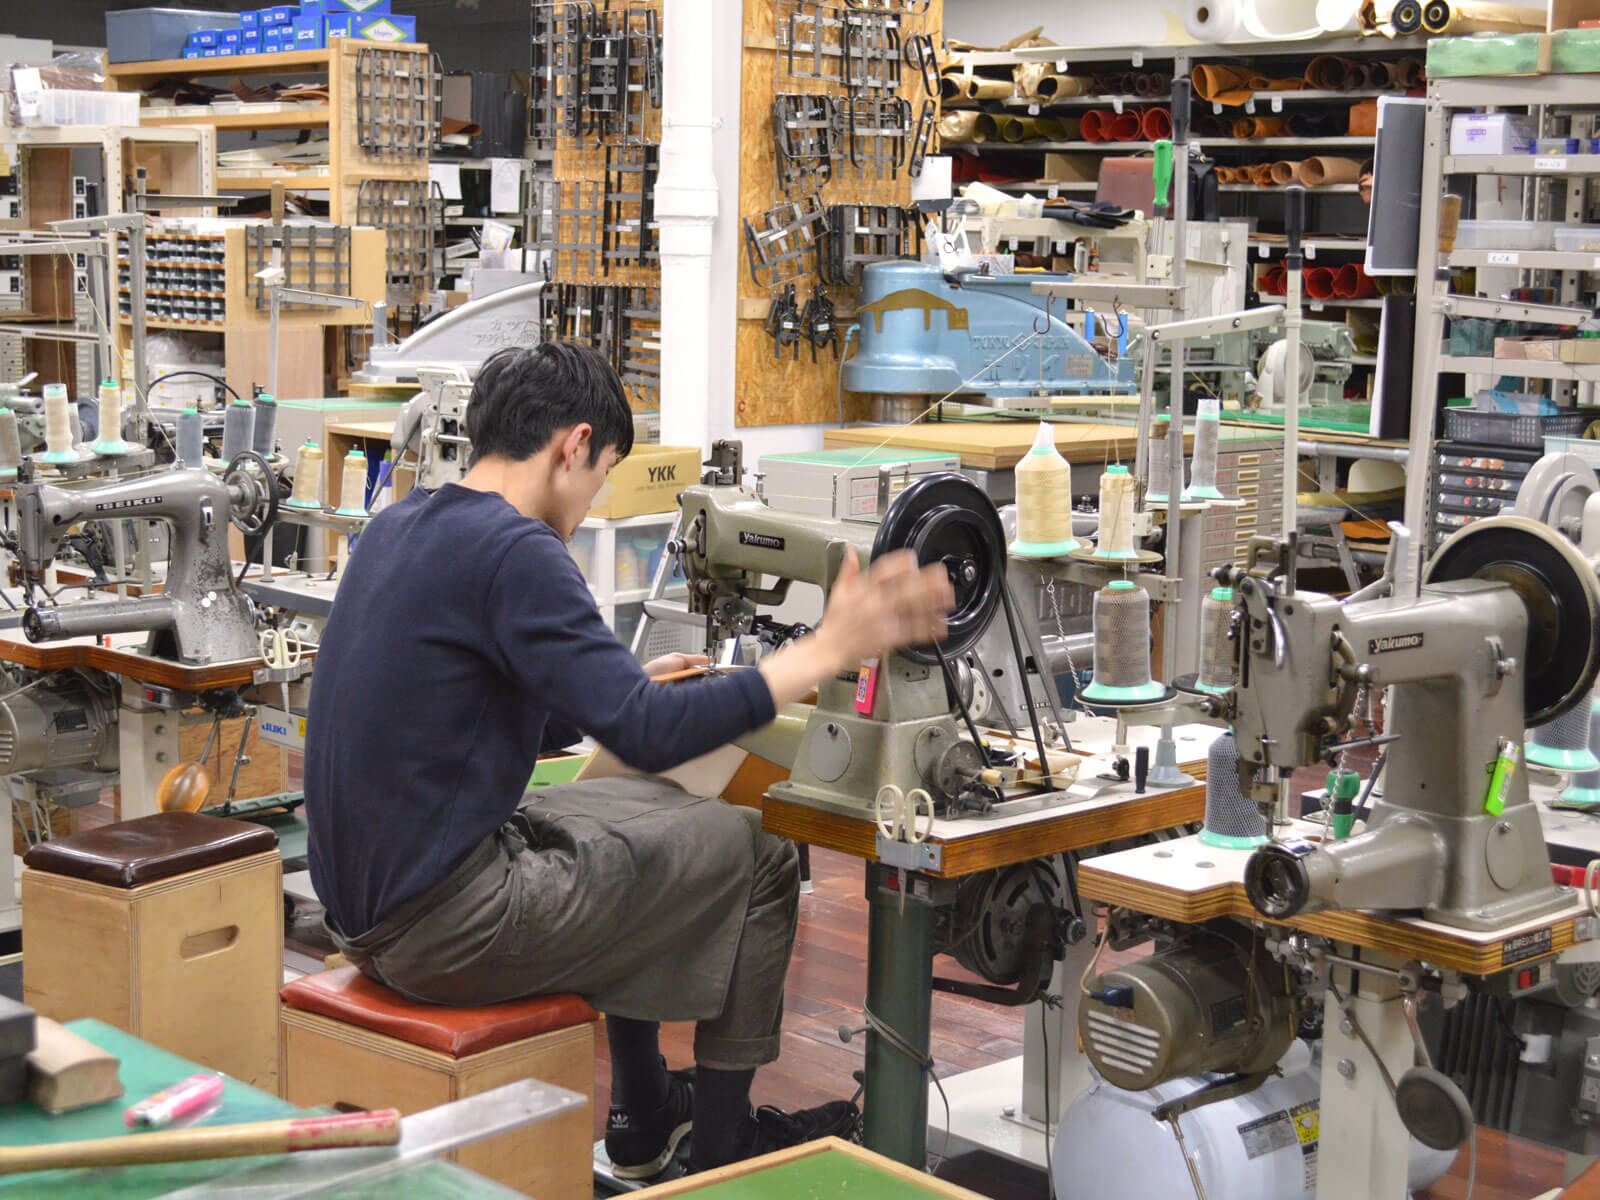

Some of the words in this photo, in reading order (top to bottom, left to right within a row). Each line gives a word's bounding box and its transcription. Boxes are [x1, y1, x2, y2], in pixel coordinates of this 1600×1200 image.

[647, 464, 677, 483] YKK
[103, 497, 155, 510] SEIKO
[743, 531, 781, 548] Yakumo
[1373, 635, 1419, 653] Yakumo
[261, 721, 287, 736] JUKI
